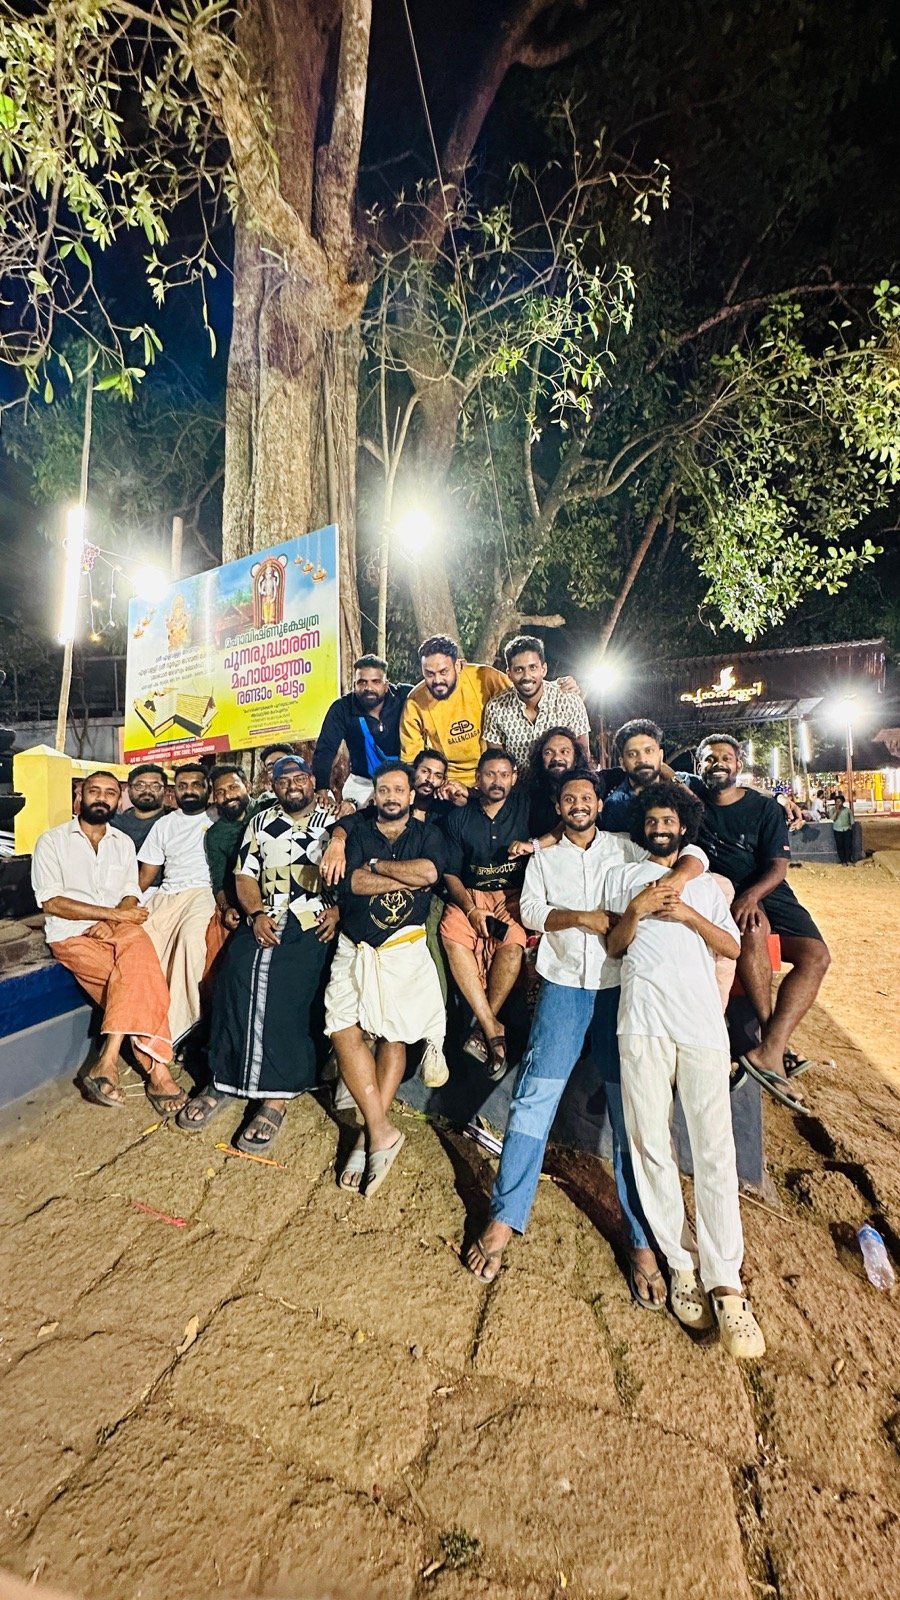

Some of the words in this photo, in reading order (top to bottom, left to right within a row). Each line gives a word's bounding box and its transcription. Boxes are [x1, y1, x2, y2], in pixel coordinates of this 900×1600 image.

[224, 630, 320, 671] പുനരുദ്ധാരണ
[231, 658, 312, 689] മഹായജ്ഞം
[237, 687, 272, 705] രണ്ടാം
[276, 680, 305, 698] ഘട്ടം
[447, 728, 480, 745] BALENCIAGA
